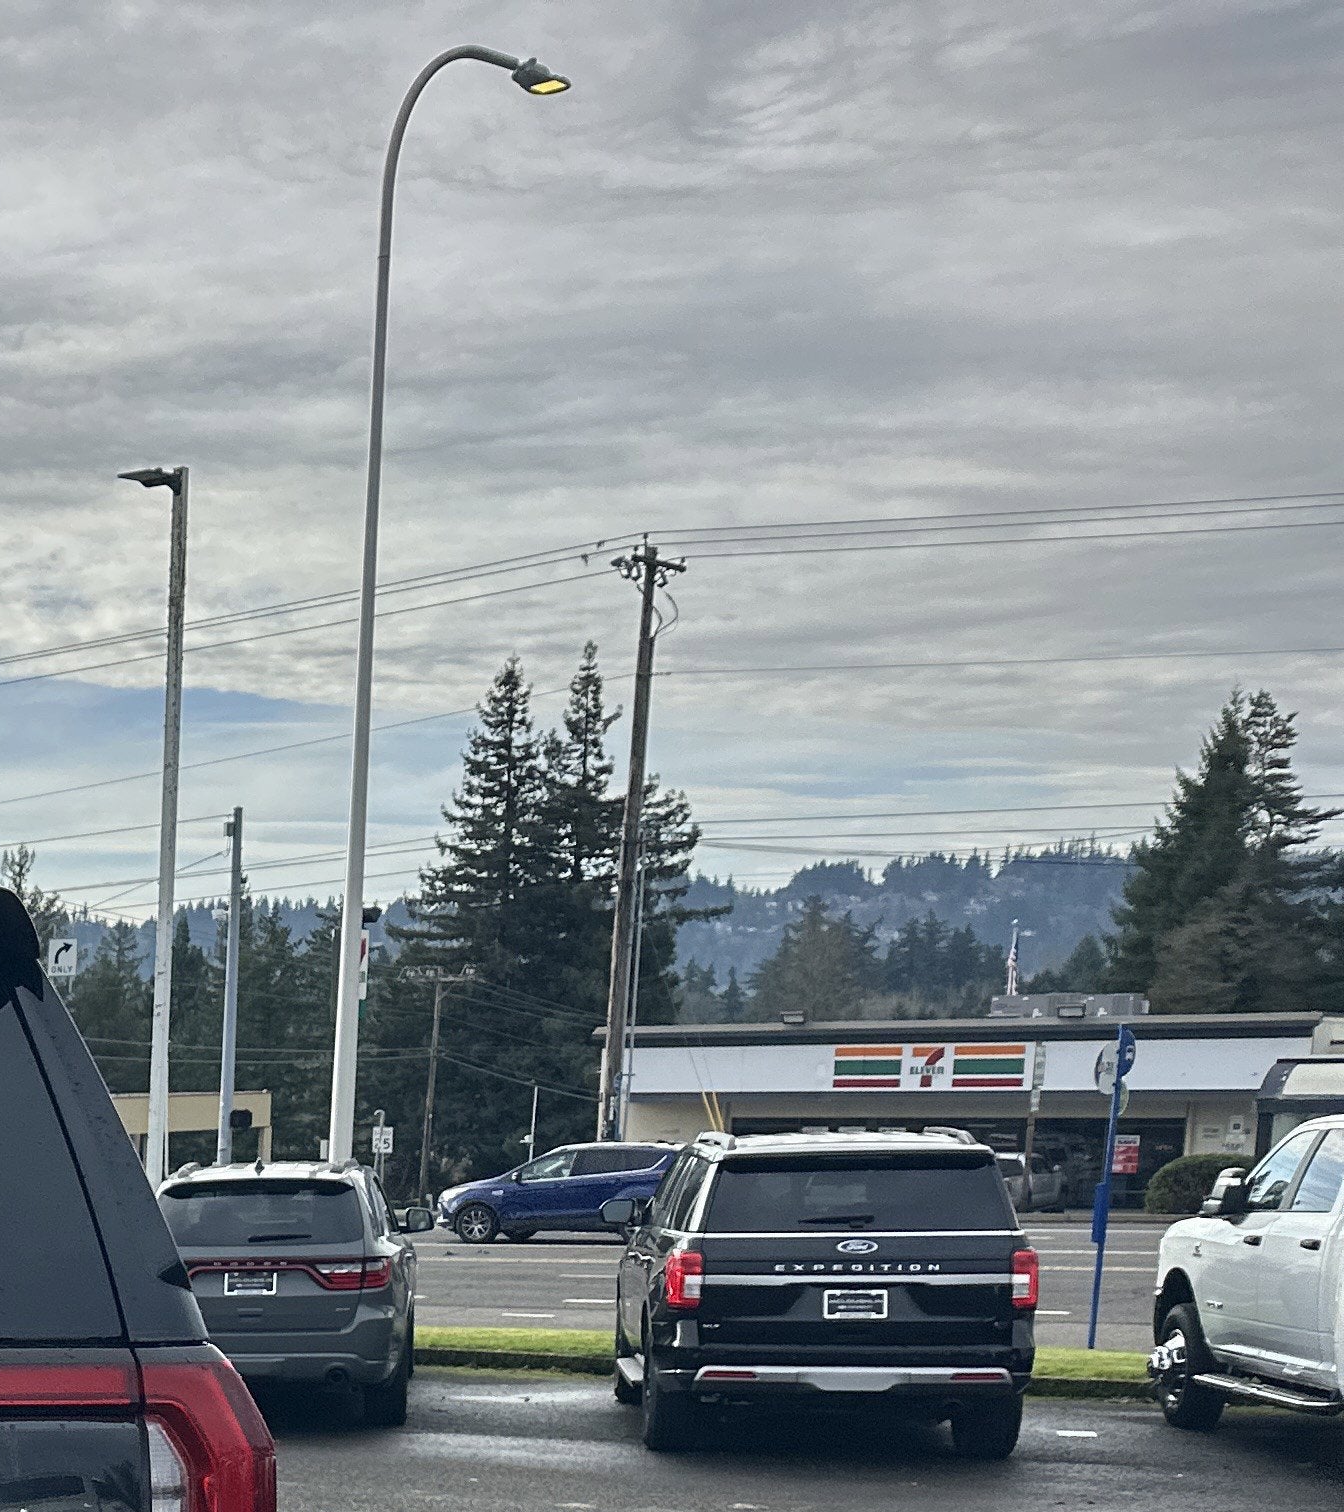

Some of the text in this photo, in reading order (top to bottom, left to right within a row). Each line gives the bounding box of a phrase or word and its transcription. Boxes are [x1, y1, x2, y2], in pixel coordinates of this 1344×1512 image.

[51, 965, 73, 974] ONLY
[912, 1046, 945, 1087] 7
[773, 1262, 942, 1272] EXPEDITION
